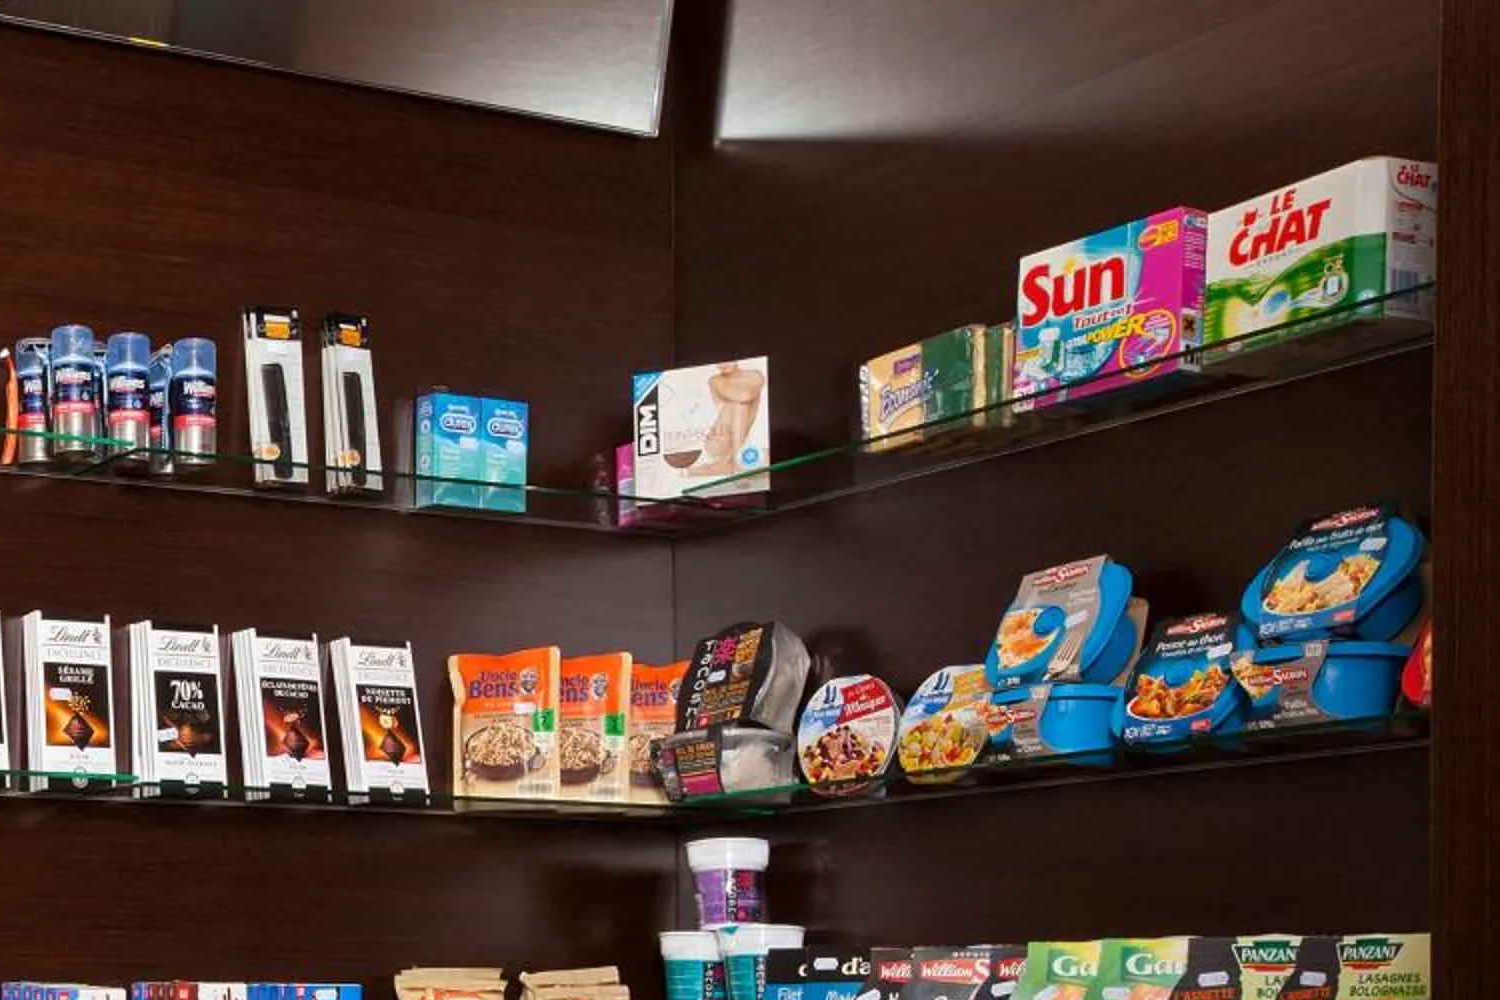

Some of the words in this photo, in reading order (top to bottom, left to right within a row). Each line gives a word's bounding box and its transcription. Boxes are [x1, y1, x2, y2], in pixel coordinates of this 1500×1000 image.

[1396, 170, 1431, 189] CHAT
[1269, 188, 1297, 215] LE
[1229, 198, 1332, 268] CHAT
[1022, 256, 1125, 328] Sun
[1086, 314, 1146, 344] POWER
[638, 403, 658, 455] DIM
[48, 625, 91, 643] Lindt
[157, 639, 198, 653] Lindt
[262, 644, 300, 660] Lindt
[357, 652, 395, 667] Lindt
[480, 668, 517, 683] Uncle
[170, 679, 204, 701] 70%
[171, 701, 205, 710] CACAO
[1241, 947, 1297, 962] PANZAN
[1342, 944, 1397, 961] PANZANI
[1358, 972, 1421, 984] LASAGNES
[1349, 985, 1426, 998] BOLOGNAISE
